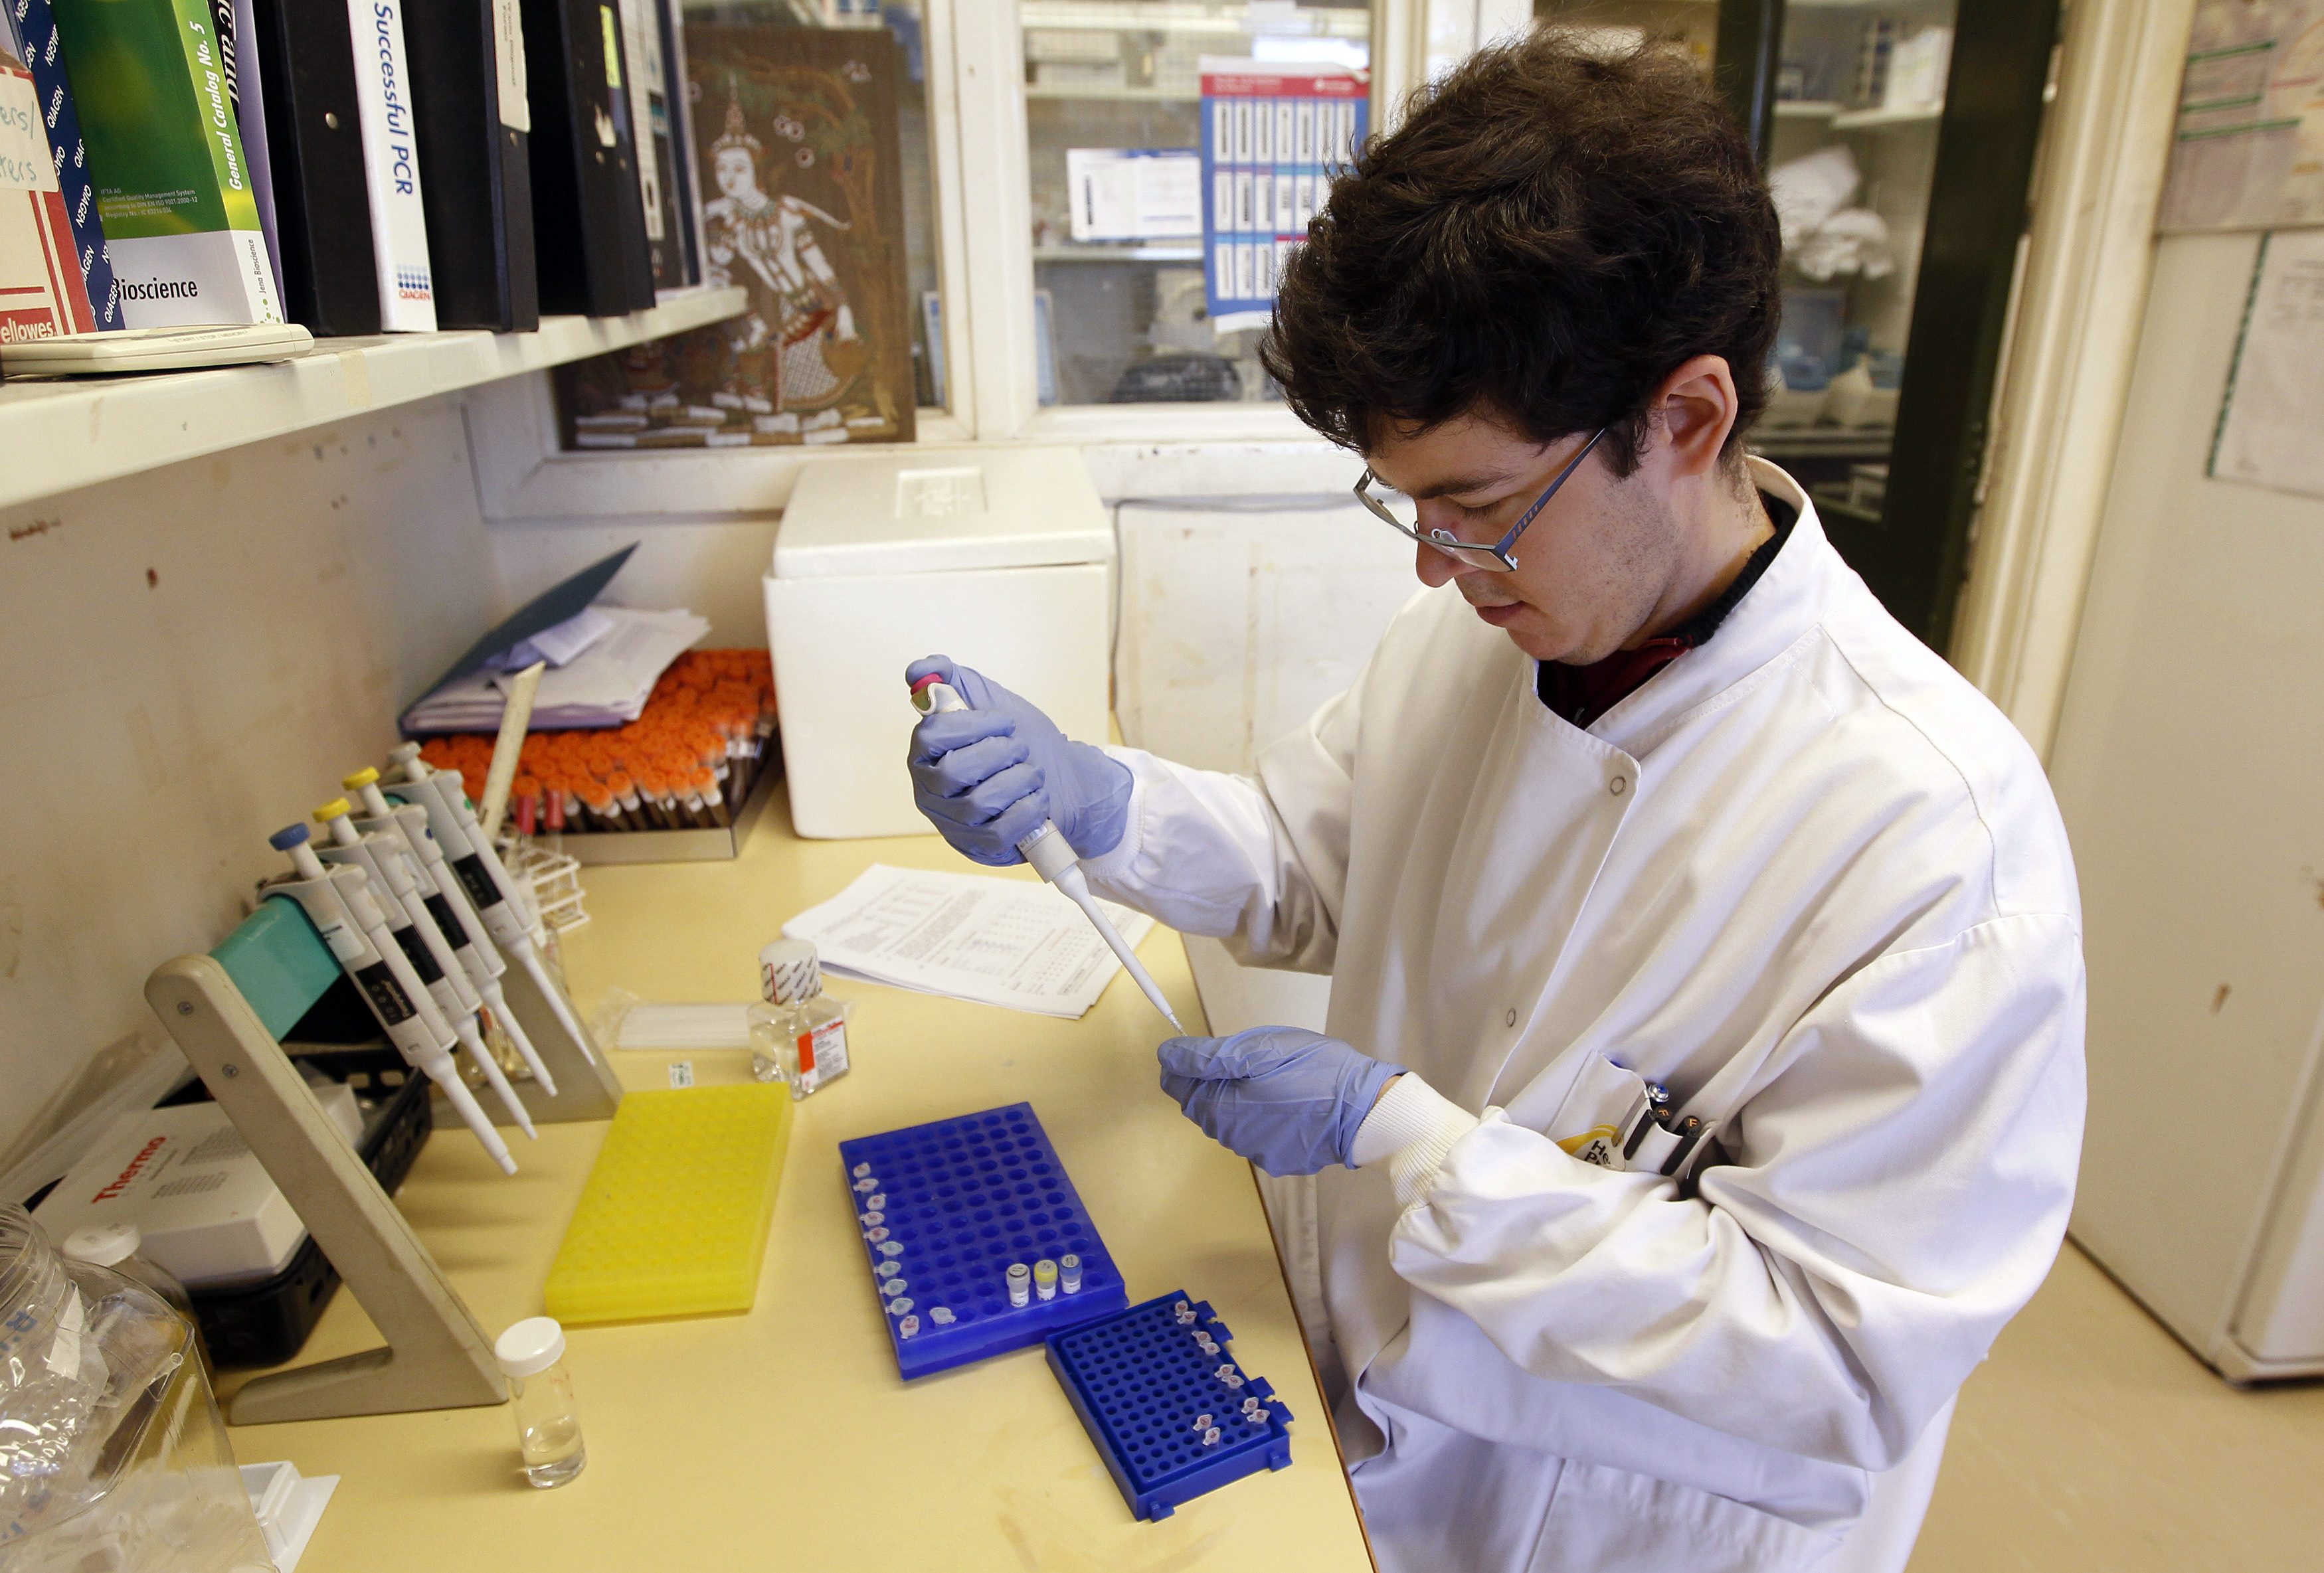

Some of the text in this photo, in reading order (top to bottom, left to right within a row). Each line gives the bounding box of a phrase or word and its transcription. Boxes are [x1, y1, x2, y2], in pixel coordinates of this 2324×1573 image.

[45, 24, 59, 67] IAGEN
[0, 101, 34, 139] ers/
[47, 84, 64, 129] QIAGEN
[189, 21, 243, 191] General Catalog No. 5
[375, 2, 413, 195] Successful PCR
[75, 184, 92, 228] QIAGEN
[248, 239, 267, 294] Jena Bioscience
[104, 280, 118, 323] QIAGEN
[1, 317, 54, 343] ellowes
[1689, 1118, 1698, 1127] F
[91, 1135, 166, 1203] Thermo
